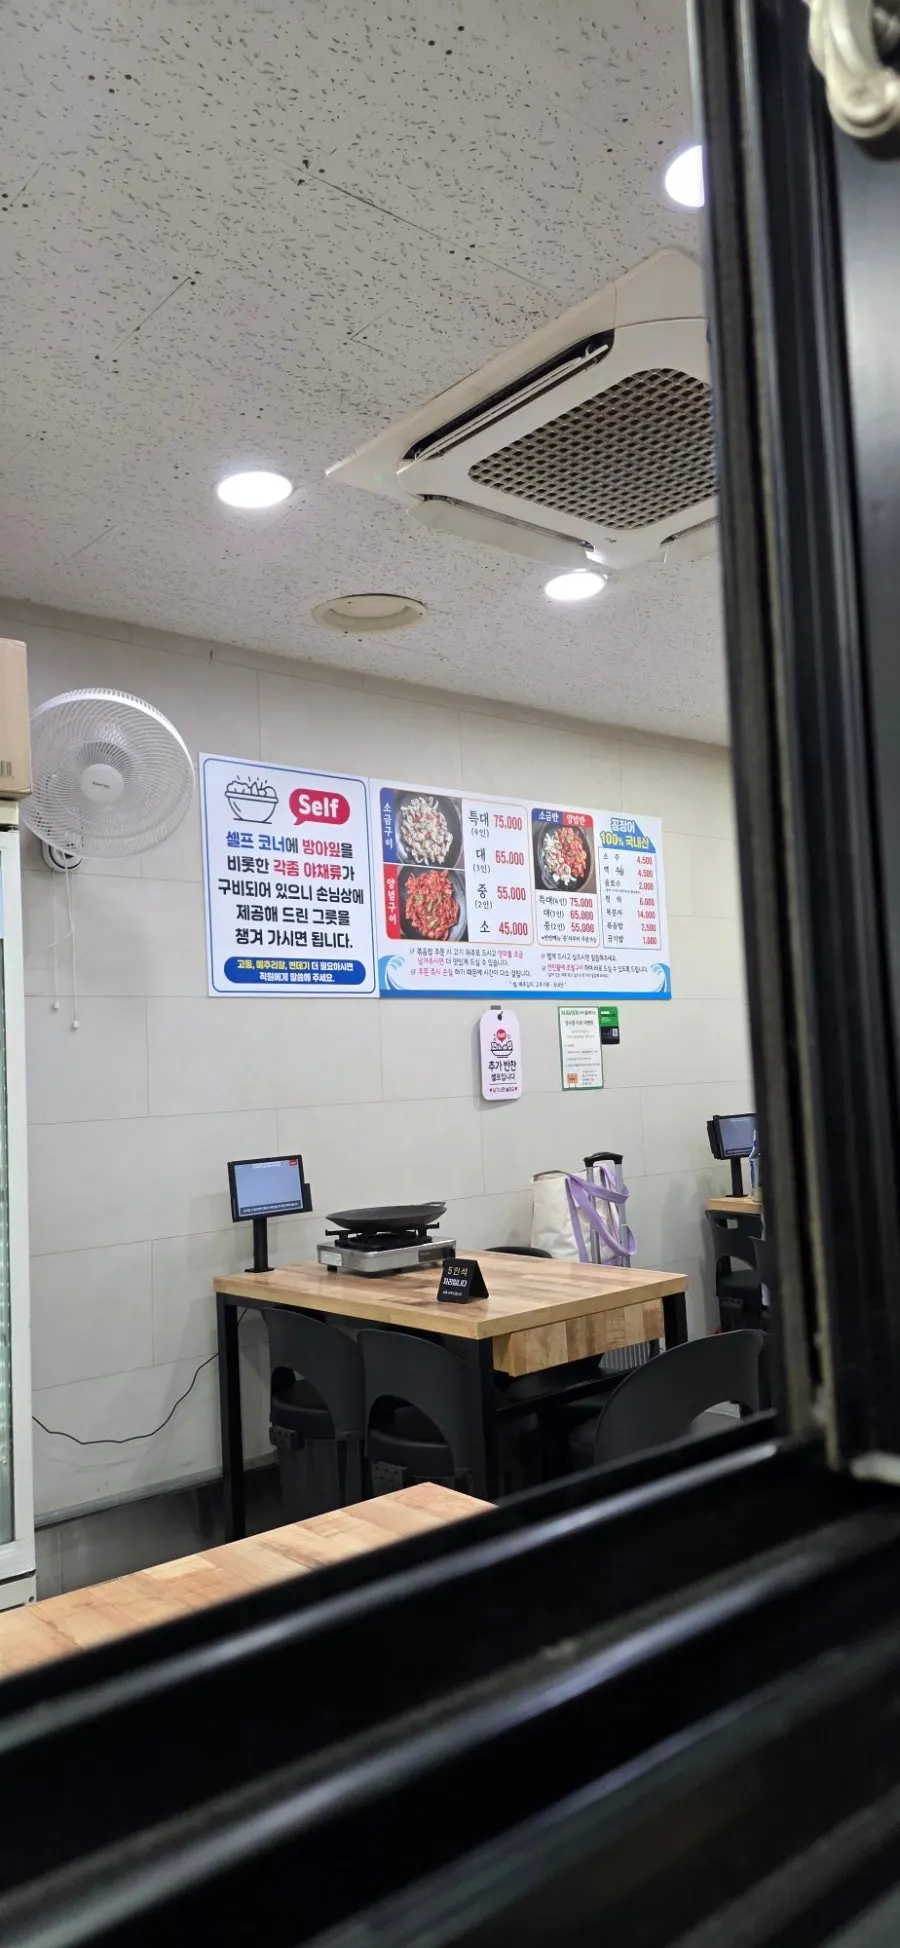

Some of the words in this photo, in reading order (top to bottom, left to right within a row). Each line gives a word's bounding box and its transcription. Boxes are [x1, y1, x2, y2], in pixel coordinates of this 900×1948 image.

[298, 794, 340, 818] Self
[468, 810, 489, 828] 특대
[538, 810, 559, 823] 소금반
[566, 814, 586, 826] 양념반
[383, 802, 393, 850] 소금구이
[471, 827, 490, 838] (4인)
[226, 830, 254, 849] 셀프
[258, 834, 299, 853] 코너에
[302, 838, 353, 859] 방아잎을
[600, 831, 624, 847] 100%
[625, 835, 650, 849] 국내산
[475, 847, 486, 863] 대
[227, 855, 270, 874] 비롯한
[273, 859, 300, 877] 각종
[303, 861, 355, 881] 야채류가
[473, 863, 491, 874] (3인)
[218, 878, 272, 898] 구비되어
[275, 882, 313, 901] 있으니
[316, 885, 364, 905] 손님상에
[477, 883, 488, 899] 중
[386, 878, 397, 925] 양념구이
[475, 899, 493, 911] (2인)
[236, 904, 278, 922] 제공해
[282, 906, 309, 924] 드린
[312, 908, 350, 926] 그릇을
[479, 919, 491, 933] 소
[498, 921, 528, 936] 45,000
[544, 920, 566, 931] 중(2인)
[235, 928, 263, 945] 챙겨
[268, 929, 308, 947] 가시면
[311, 931, 353, 949] 됩니다.
[311, 961, 319, 971] 더
[320, 962, 354, 972] 필요하시면
[470, 958, 480, 967] 드실
[259, 972, 288, 982] 직원에게
[289, 972, 311, 983] 말씀해
[312, 973, 335, 983] 주세요.
[418, 967, 429, 977] 주문
[454, 968, 466, 976] 하기
[483, 969, 499, 978] 시간이
[499, 969, 510, 977] 다소
[488, 1060, 502, 1072] 추가
[447, 1266, 468, 1276] 5인석
